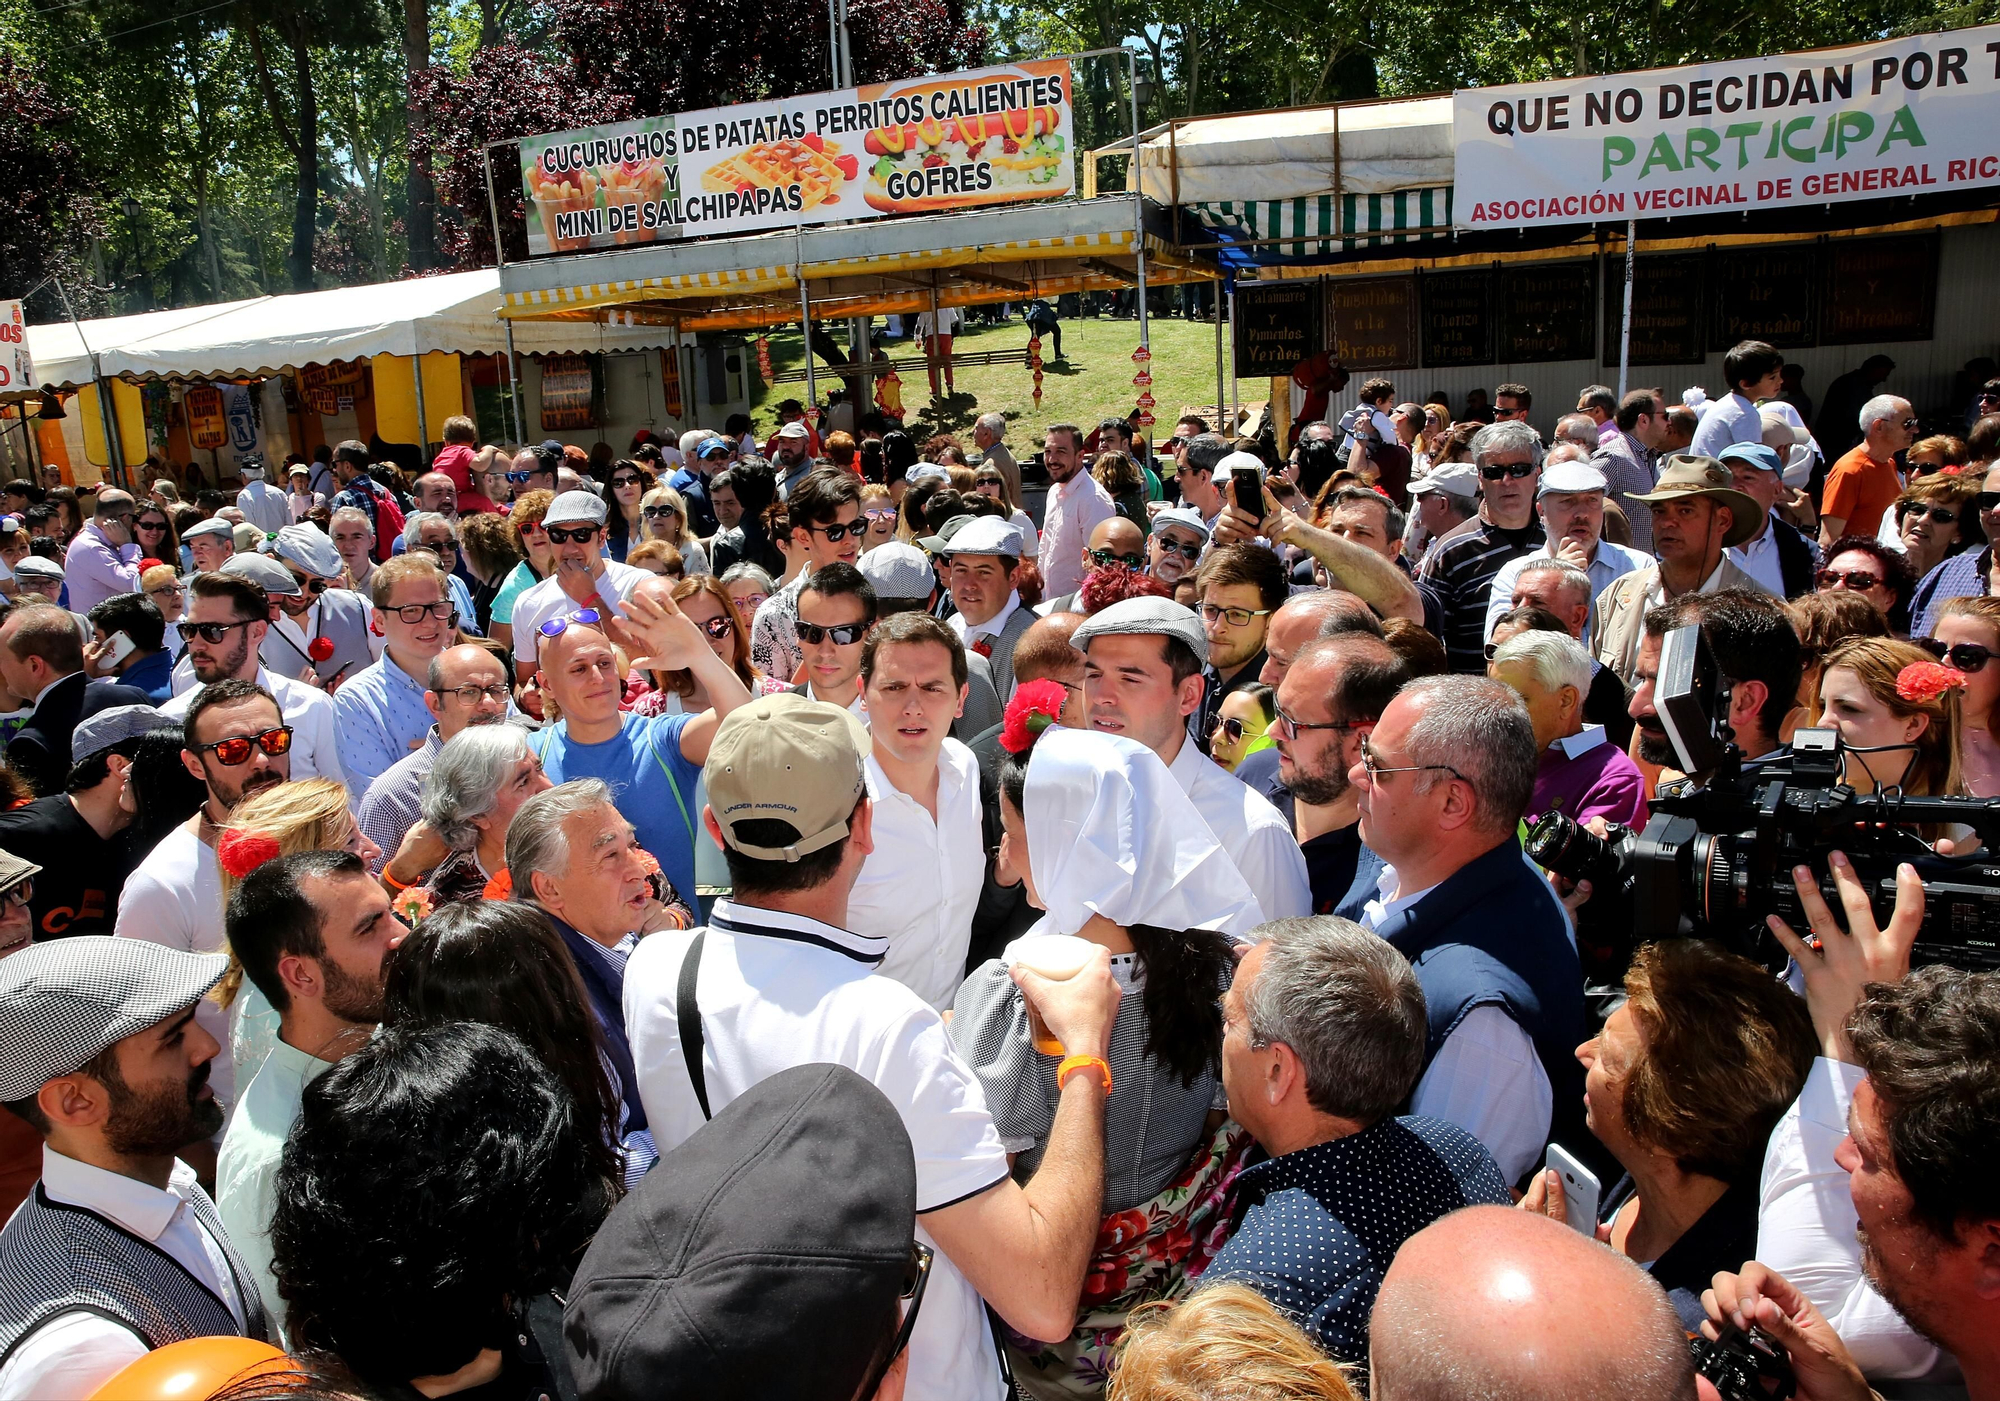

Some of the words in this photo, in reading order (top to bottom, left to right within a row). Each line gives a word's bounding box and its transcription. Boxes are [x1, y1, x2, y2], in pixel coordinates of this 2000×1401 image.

[816, 95, 924, 135] PERRITOS
[930, 75, 1063, 119] CALIENTES
[1487, 95, 1570, 137] QUE
[1584, 88, 1643, 127] NO
[1658, 64, 1853, 120] DECIDAN
[1871, 47, 1969, 95] POR
[543, 130, 677, 173] CUCURUCHOS
[682, 125, 710, 153] DE
[715, 111, 806, 148] PATATAS
[1602, 104, 1927, 183] PARTICIPA
[664, 165, 678, 190] Y
[887, 162, 992, 200] GOFRES
[1470, 189, 1624, 222] ASOCIACIÓN
[1634, 183, 1747, 211] VECINAL
[1757, 178, 1792, 201] DE
[1802, 164, 1937, 195] GENERAL
[1947, 156, 2000, 182] RIC
[556, 209, 601, 238] MINI
[608, 204, 637, 232] DE
[643, 184, 803, 227] SALCHIPAPAS
[1728, 313, 1802, 335] Pescado
[1248, 345, 1302, 362] Verdes
[1338, 340, 1397, 360] Brasa
[724, 803, 752, 815] UNDER
[755, 803, 798, 814] ARMOUR
[1966, 939, 1996, 948] XDCAM
